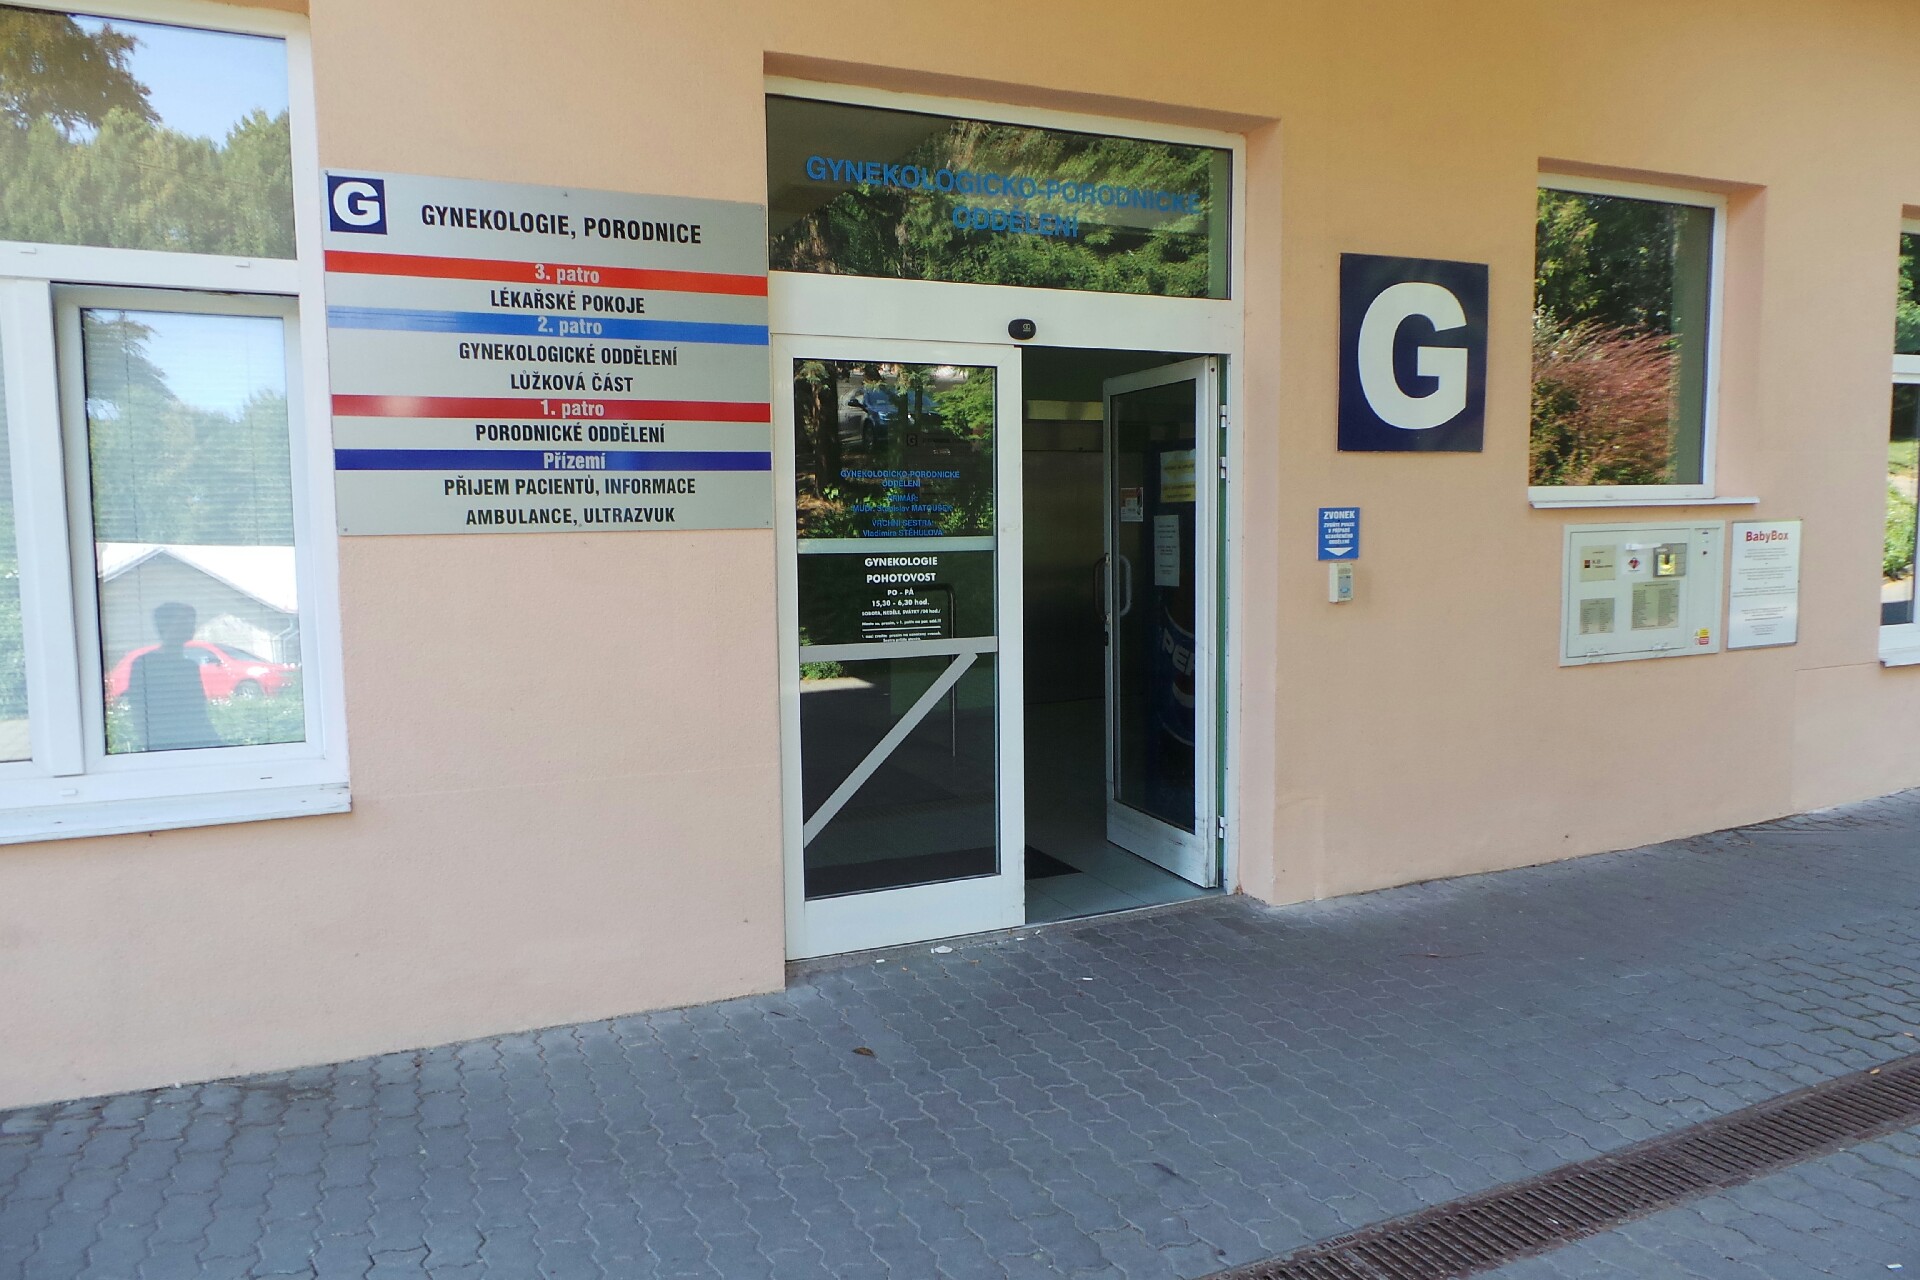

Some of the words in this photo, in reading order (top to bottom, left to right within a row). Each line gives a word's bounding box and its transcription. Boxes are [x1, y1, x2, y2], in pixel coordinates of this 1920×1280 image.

[333, 181, 381, 227] G
[421, 204, 576, 239] GYNEKOLOGIE,
[584, 217, 702, 244] PORODNICE
[534, 263, 551, 281] 3.
[556, 264, 600, 285] patro
[490, 286, 577, 311] LÉKAŘSKÉ
[582, 294, 645, 314] POKOJE
[537, 315, 554, 333] 2.
[559, 316, 603, 337] patro
[459, 342, 595, 364] GYNEKOLOGICKÉ
[601, 344, 678, 366] ODDĚLENÍ
[1358, 282, 1469, 430] G
[510, 369, 586, 391] LŮŽKOVÁ
[592, 371, 634, 393] ČÁST
[540, 399, 556, 416] 1.
[561, 400, 605, 419] patro
[475, 422, 583, 442] PORODNICKÉ
[588, 423, 665, 443] ODDĚLENÍ
[543, 452, 606, 470] Přízemí
[444, 475, 510, 496] PŘIJEM
[515, 474, 600, 496] PACIENTŮ,
[605, 478, 696, 495] INFORMACE
[466, 508, 578, 526] AMBULANCE,
[583, 507, 675, 524] ULTRAZVUK
[1323, 510, 1355, 520] ZVONEK
[1745, 530, 1789, 543] BabyBox
[864, 556, 938, 567] GYNEKOLOGIE
[866, 572, 937, 584] POHOTOVOST
[904, 587, 914, 596] PÁ
[872, 599, 891, 608] 15,30
[897, 599, 913, 608] 6,30
[914, 598, 930, 606] hod.
